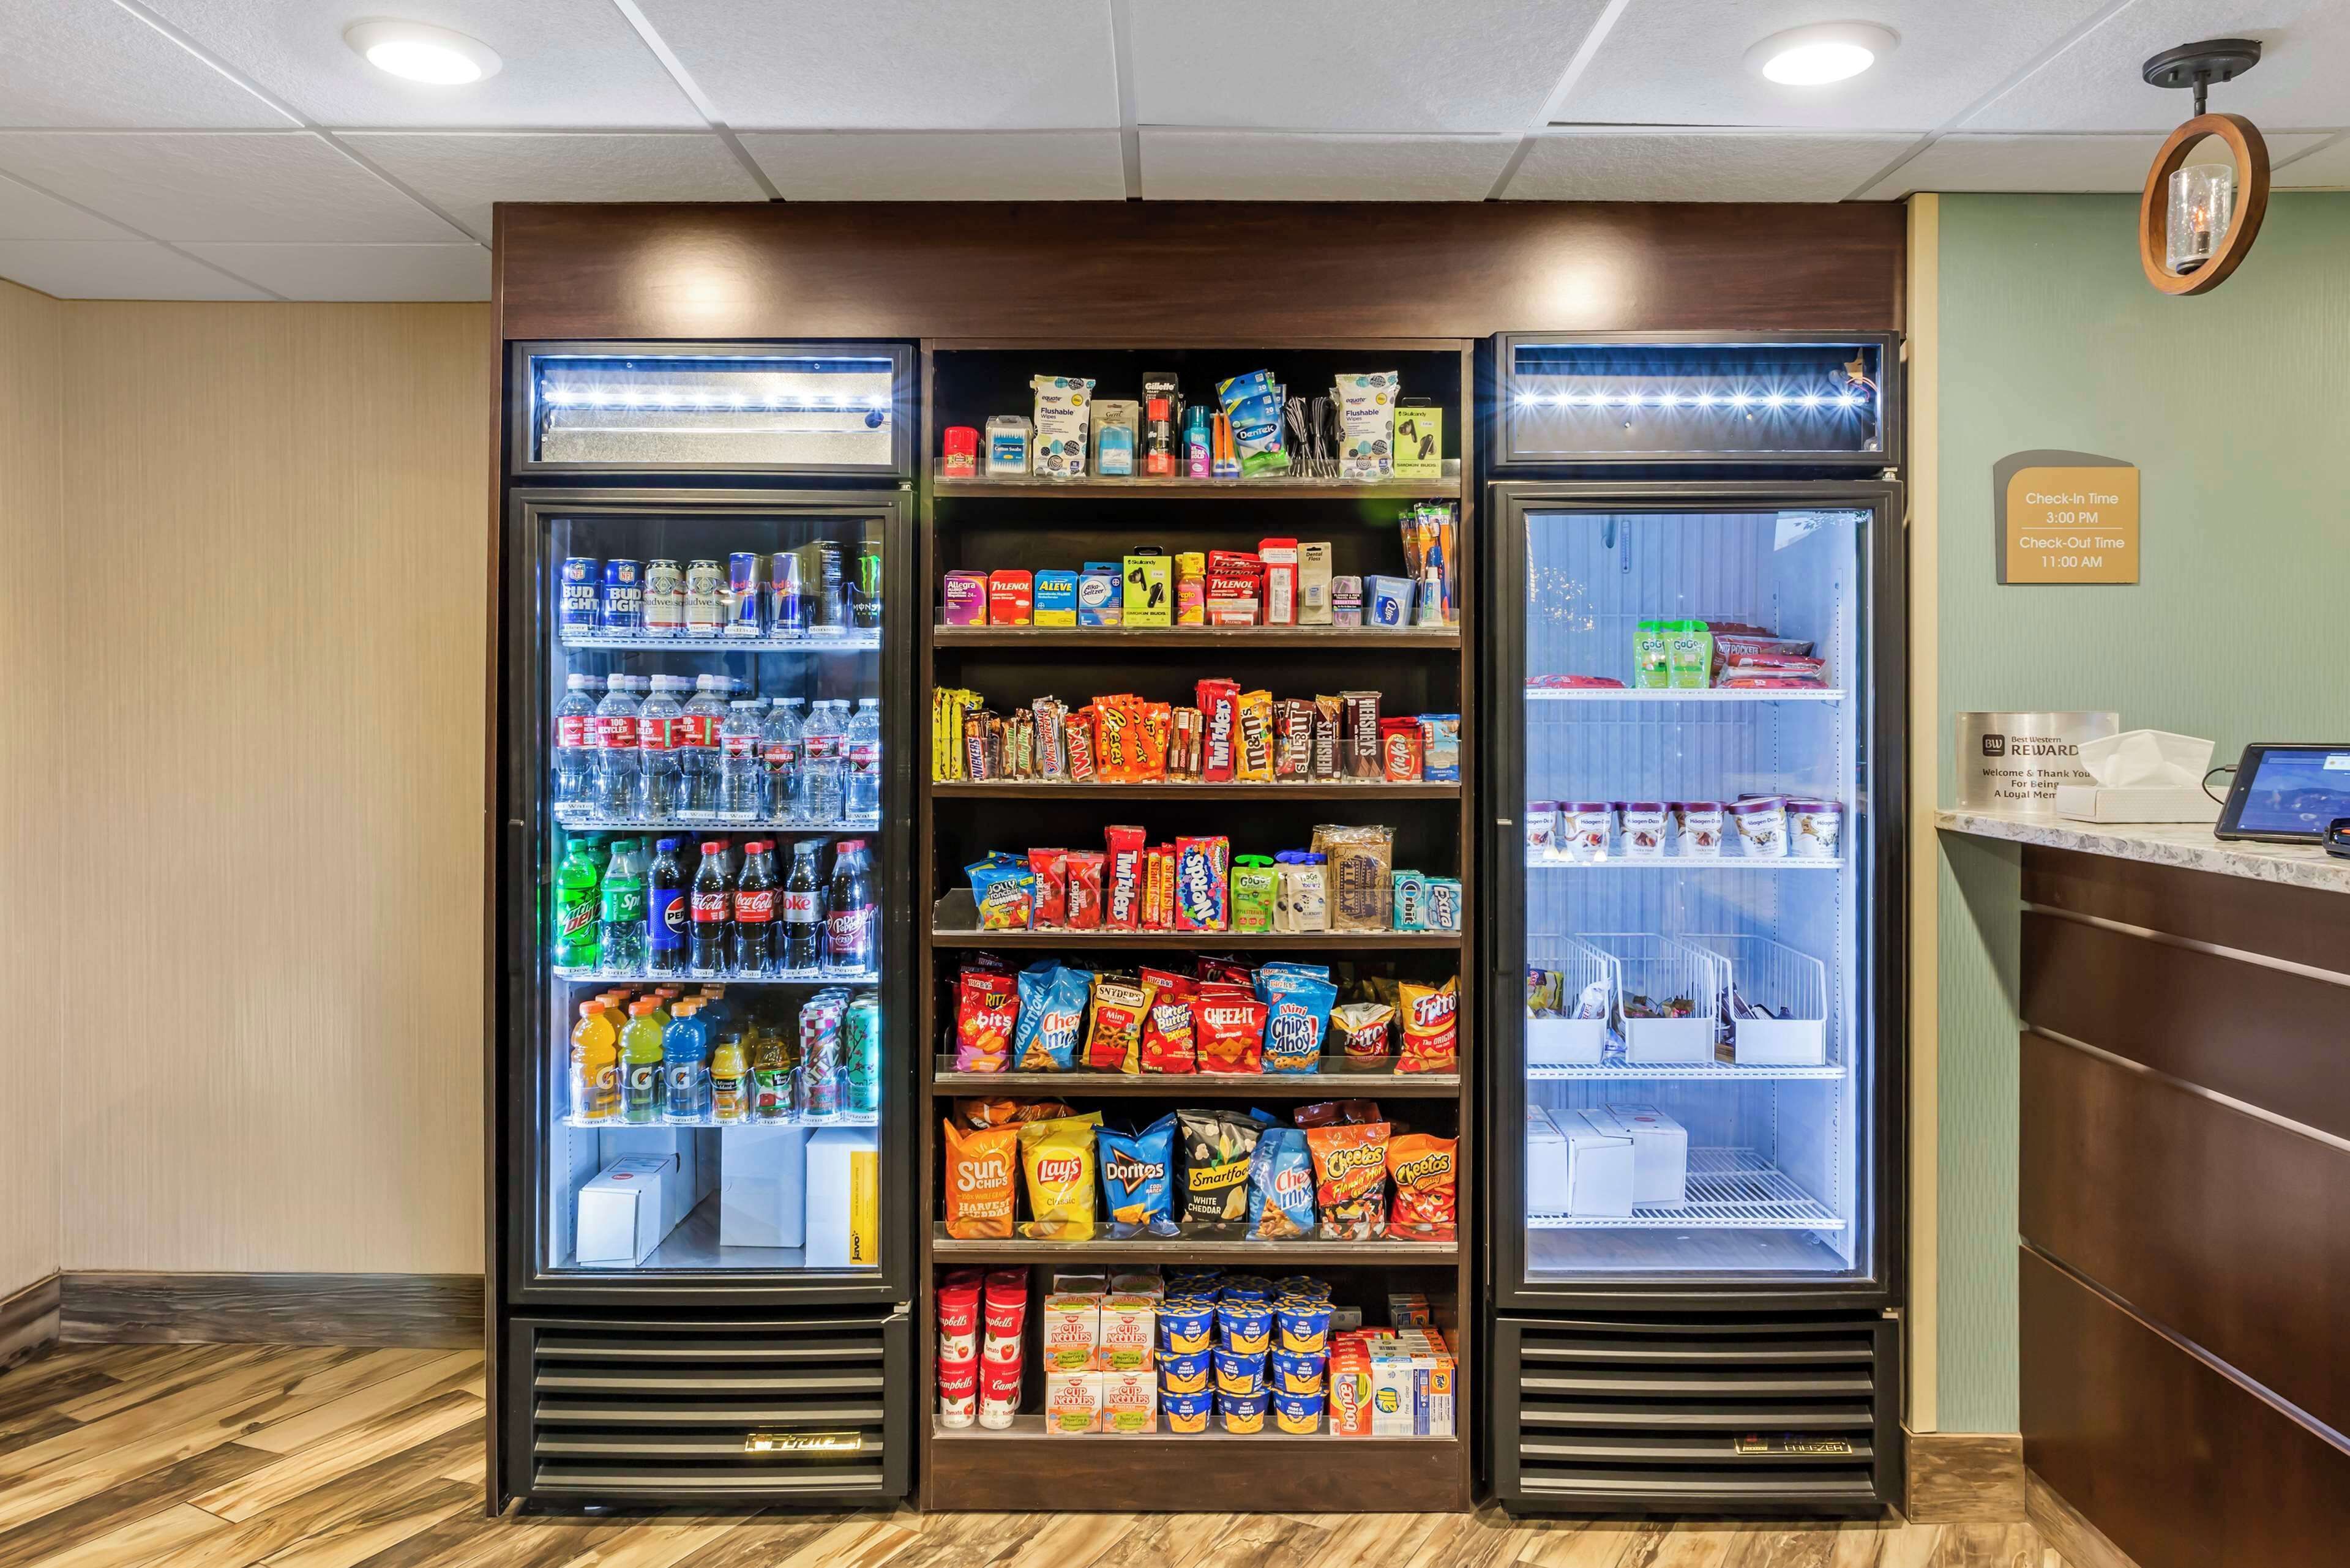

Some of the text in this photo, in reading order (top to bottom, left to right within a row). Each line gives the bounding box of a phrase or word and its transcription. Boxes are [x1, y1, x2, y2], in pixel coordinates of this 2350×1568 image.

[2026, 492, 2119, 504] Check-In Time
[2046, 512, 2098, 524] 3:00 PM
[2019, 537, 2125, 548] Check-Out Time
[2041, 556, 2103, 567] 11:00 AM
[572, 570, 583, 579] NFL
[620, 571, 633, 580] NFL
[948, 581, 976, 590] Allegra
[992, 581, 1030, 591] TYLENOL
[1038, 581, 1072, 591] ALEVE
[1211, 579, 1254, 589] TYLENOL
[563, 586, 594, 598] BUD
[610, 588, 642, 600] BUD
[1731, 644, 1759, 655] POCKETS
[610, 718, 627, 727] 100%
[1359, 699, 1376, 756] HERSHEY'S
[1106, 707, 1127, 766] Reese's
[1208, 700, 1232, 769] Twizzlers
[1317, 721, 1333, 774] HERSHEY'S
[1985, 739, 2003, 749] BW
[2011, 744, 2079, 756] REWARD
[1018, 744, 1031, 769] Milky
[1045, 761, 1060, 774] 3
[1983, 768, 2090, 778] Welcome & Thank You
[2011, 779, 2060, 790] For Being
[2004, 790, 2030, 799] Loyal
[1214, 846, 1222, 875] rainbow
[989, 881, 1016, 894] JOLLY
[1113, 851, 1138, 921] Twizzlers
[1150, 861, 1160, 906] Starburst
[1164, 865, 1174, 908] Starburst
[1344, 867, 1356, 909] ACT II
[990, 888, 1020, 900] rancher
[1035, 873, 1044, 909] Twizzlers
[735, 892, 774, 909] Coca-Cola
[989, 893, 1022, 907] GUMMIES
[1070, 880, 1080, 917] Twizzlers
[1400, 879, 1422, 925] Orbit
[1433, 887, 1453, 927] Extra
[836, 915, 862, 932] Dr Pepper
[968, 979, 979, 988] BIG
[1147, 976, 1173, 988] BIG BAG
[1284, 980, 1296, 989] BAG
[986, 993, 1007, 1007] RITZ
[1098, 986, 1141, 1002] SNYDER'S
[1015, 982, 1049, 1052] TRADITIONAL
[1106, 1010, 1125, 1021] Mini
[1153, 1004, 1189, 1020] Nutter
[1204, 1007, 1254, 1025] CHEEZ-IT
[1280, 1004, 1308, 1016] Mini
[979, 1012, 1011, 1028] bits
[1043, 1012, 1082, 1032] Chex
[1158, 1011, 1192, 1029] Butter
[1166, 1028, 1191, 1042] Bites
[1272, 1017, 1309, 1039] Chips
[1047, 1029, 1079, 1049] mix
[596, 1064, 614, 1091] G
[631, 1066, 653, 1090] G
[670, 1066, 690, 1090] G
[1328, 1145, 1384, 1179] Cheetos
[958, 1161, 1005, 1192] Sun
[1040, 1159, 1080, 1184] Lay's
[1106, 1162, 1164, 1181] Doritos
[1366, 1167, 1383, 1184] Hot
[1396, 1155, 1450, 1184] Cheetos
[976, 1176, 1008, 1189] CHIPS
[1193, 1168, 1250, 1187] Smartfoo
[1275, 1167, 1312, 1192] Chex
[1046, 1197, 1076, 1206] Classic
[1193, 1195, 1217, 1205] WHITE
[1282, 1185, 1312, 1207] mix
[959, 1198, 1011, 1212] HARVEST
[1188, 1203, 1221, 1215] CHEDDAR
[959, 1208, 1011, 1219] CHEDDAR
[1060, 1324, 1083, 1333] CUP
[1116, 1324, 1140, 1334] CUP
[1051, 1332, 1092, 1343] NOODLES
[1106, 1333, 1147, 1343] NOODLES
[1435, 1375, 1445, 1389] Tide
[1063, 1387, 1087, 1397] CUP
[1118, 1386, 1142, 1395] CUP
[1054, 1395, 1095, 1406] NOODLES
[1109, 1394, 1150, 1405] NOODLES
[1376, 1389, 1399, 1413] all
[1339, 1383, 1358, 1432] Bounce
